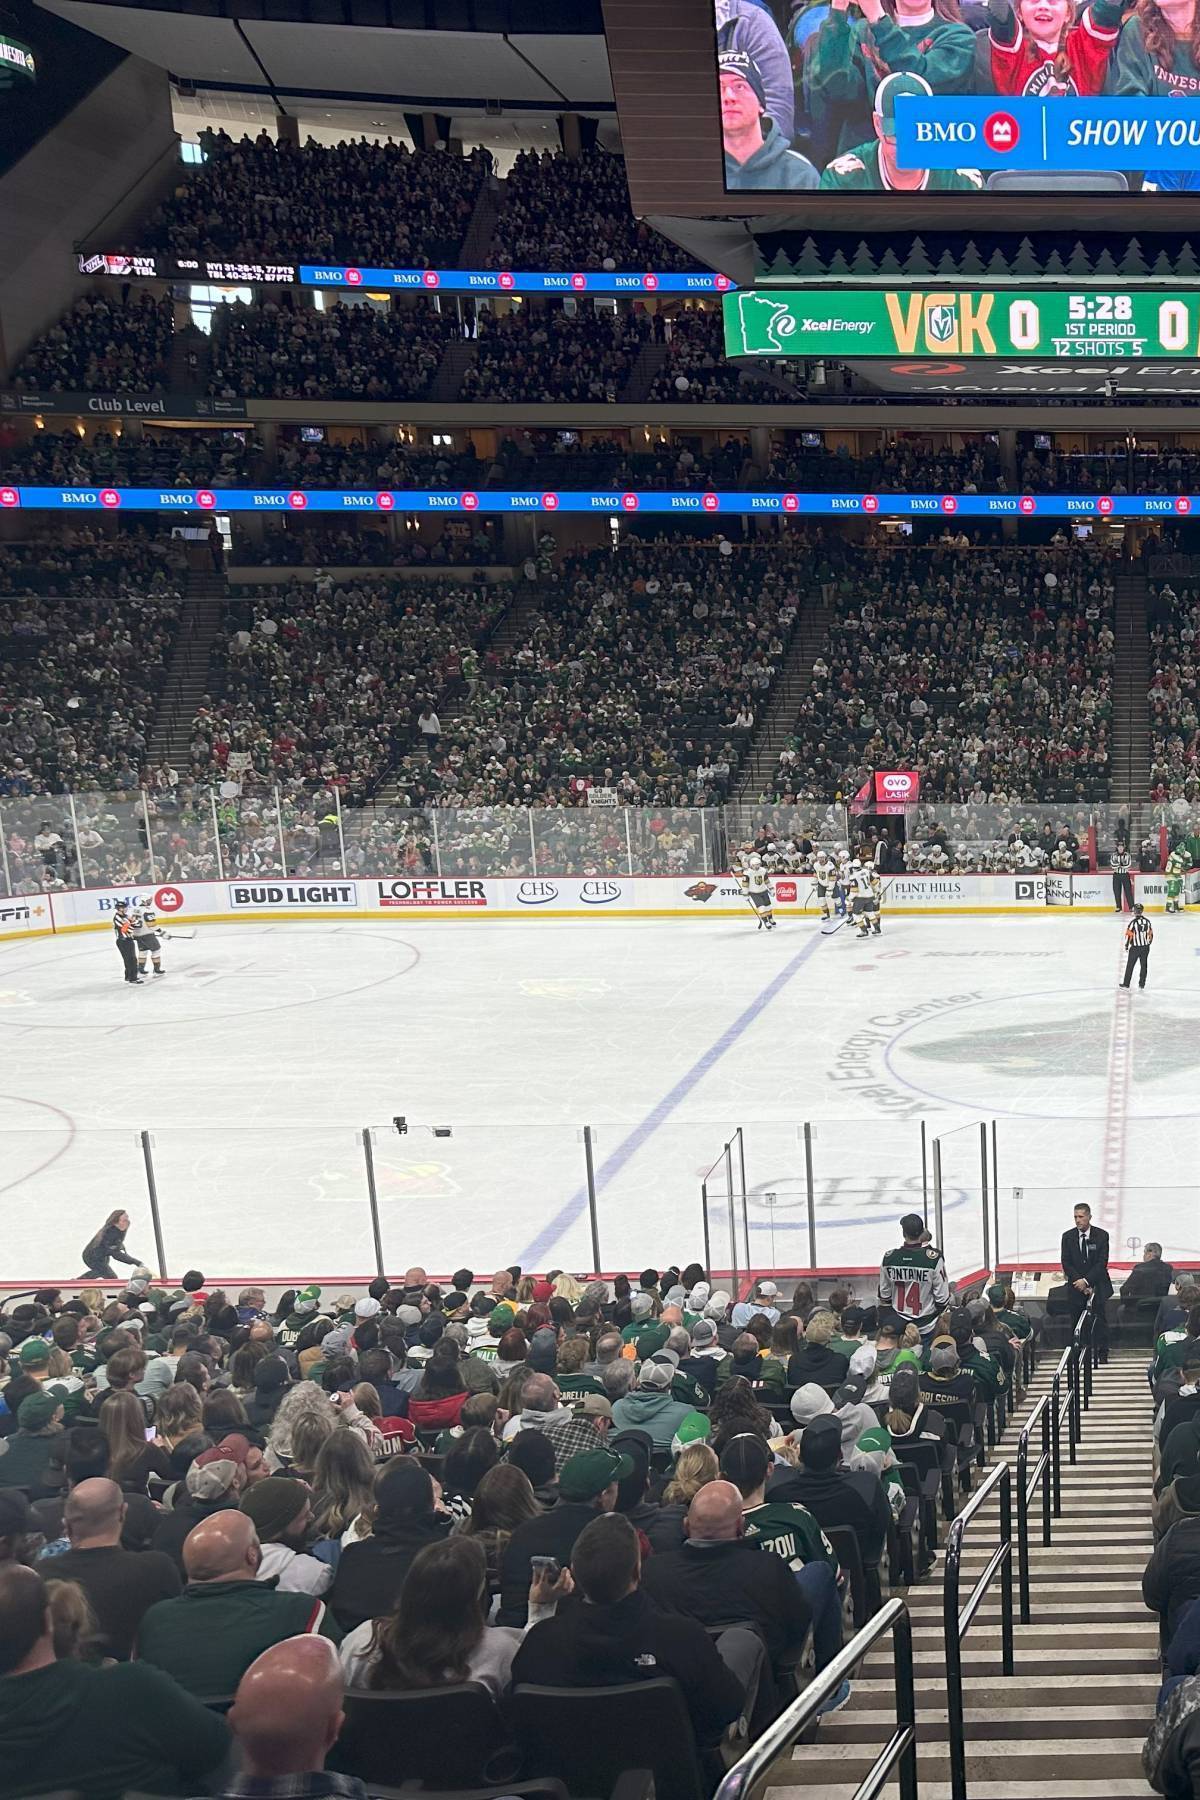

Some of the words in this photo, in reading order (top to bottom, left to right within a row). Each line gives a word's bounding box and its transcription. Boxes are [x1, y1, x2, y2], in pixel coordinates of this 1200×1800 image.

[915, 121, 977, 143] BMO
[1067, 119, 1151, 146] SHOW
[133, 257, 155, 267] NYI
[206, 262, 223, 271] NYI
[134, 266, 157, 276] TBL
[315, 272, 342, 281] BMO
[393, 274, 420, 283] BMO
[469, 276, 496, 285] BMO
[544, 277, 569, 286] BMO
[615, 277, 640, 286] BMO
[687, 278, 712, 286] BMO
[1068, 296, 1133, 320] 5:28
[884, 292, 997, 354] VGK
[1008, 300, 1040, 350] 0
[1158, 300, 1189, 351] 0
[1064, 323, 1087, 336] 1ST
[1089, 323, 1136, 336] PERIOD
[1055, 342, 1070, 356] 12
[1074, 342, 1125, 356] SHOTS
[1132, 342, 1143, 356] 5
[995, 365, 1130, 375] Xcel
[88, 397, 123, 412] Club
[126, 399, 166, 413] Level
[63, 493, 96, 503] BMO
[160, 494, 193, 504] BMO
[254, 495, 285, 505] BMO
[344, 496, 373, 506] BMO
[429, 496, 457, 506] BMO
[511, 497, 538, 506] BMO
[592, 497, 619, 506] BMO
[672, 497, 699, 507] BMO
[752, 498, 779, 507] BMO
[832, 499, 859, 508] BMO
[911, 499, 938, 509] BMO
[990, 500, 1016, 510] BMO
[1068, 500, 1094, 510] BMO
[1145, 501, 1171, 510] BMO
[377, 880, 486, 899] LOFFLER
[519, 882, 555, 896] CHS
[583, 881, 618, 896] CHS
[895, 883, 927, 893] FLINT
[930, 882, 961, 893] HILLS
[1143, 885, 1162, 894] WORK
[235, 887, 284, 904] BUD
[287, 886, 351, 903] LIGHT
[867, 990, 984, 1027] Center
[826, 1025, 892, 1081] Energy
[840, 1083, 948, 1119] Xcel
[893, 1281, 922, 1316] 14
[476, 1350, 497, 1362] WALT
[559, 1390, 590, 1400] CARELLO
